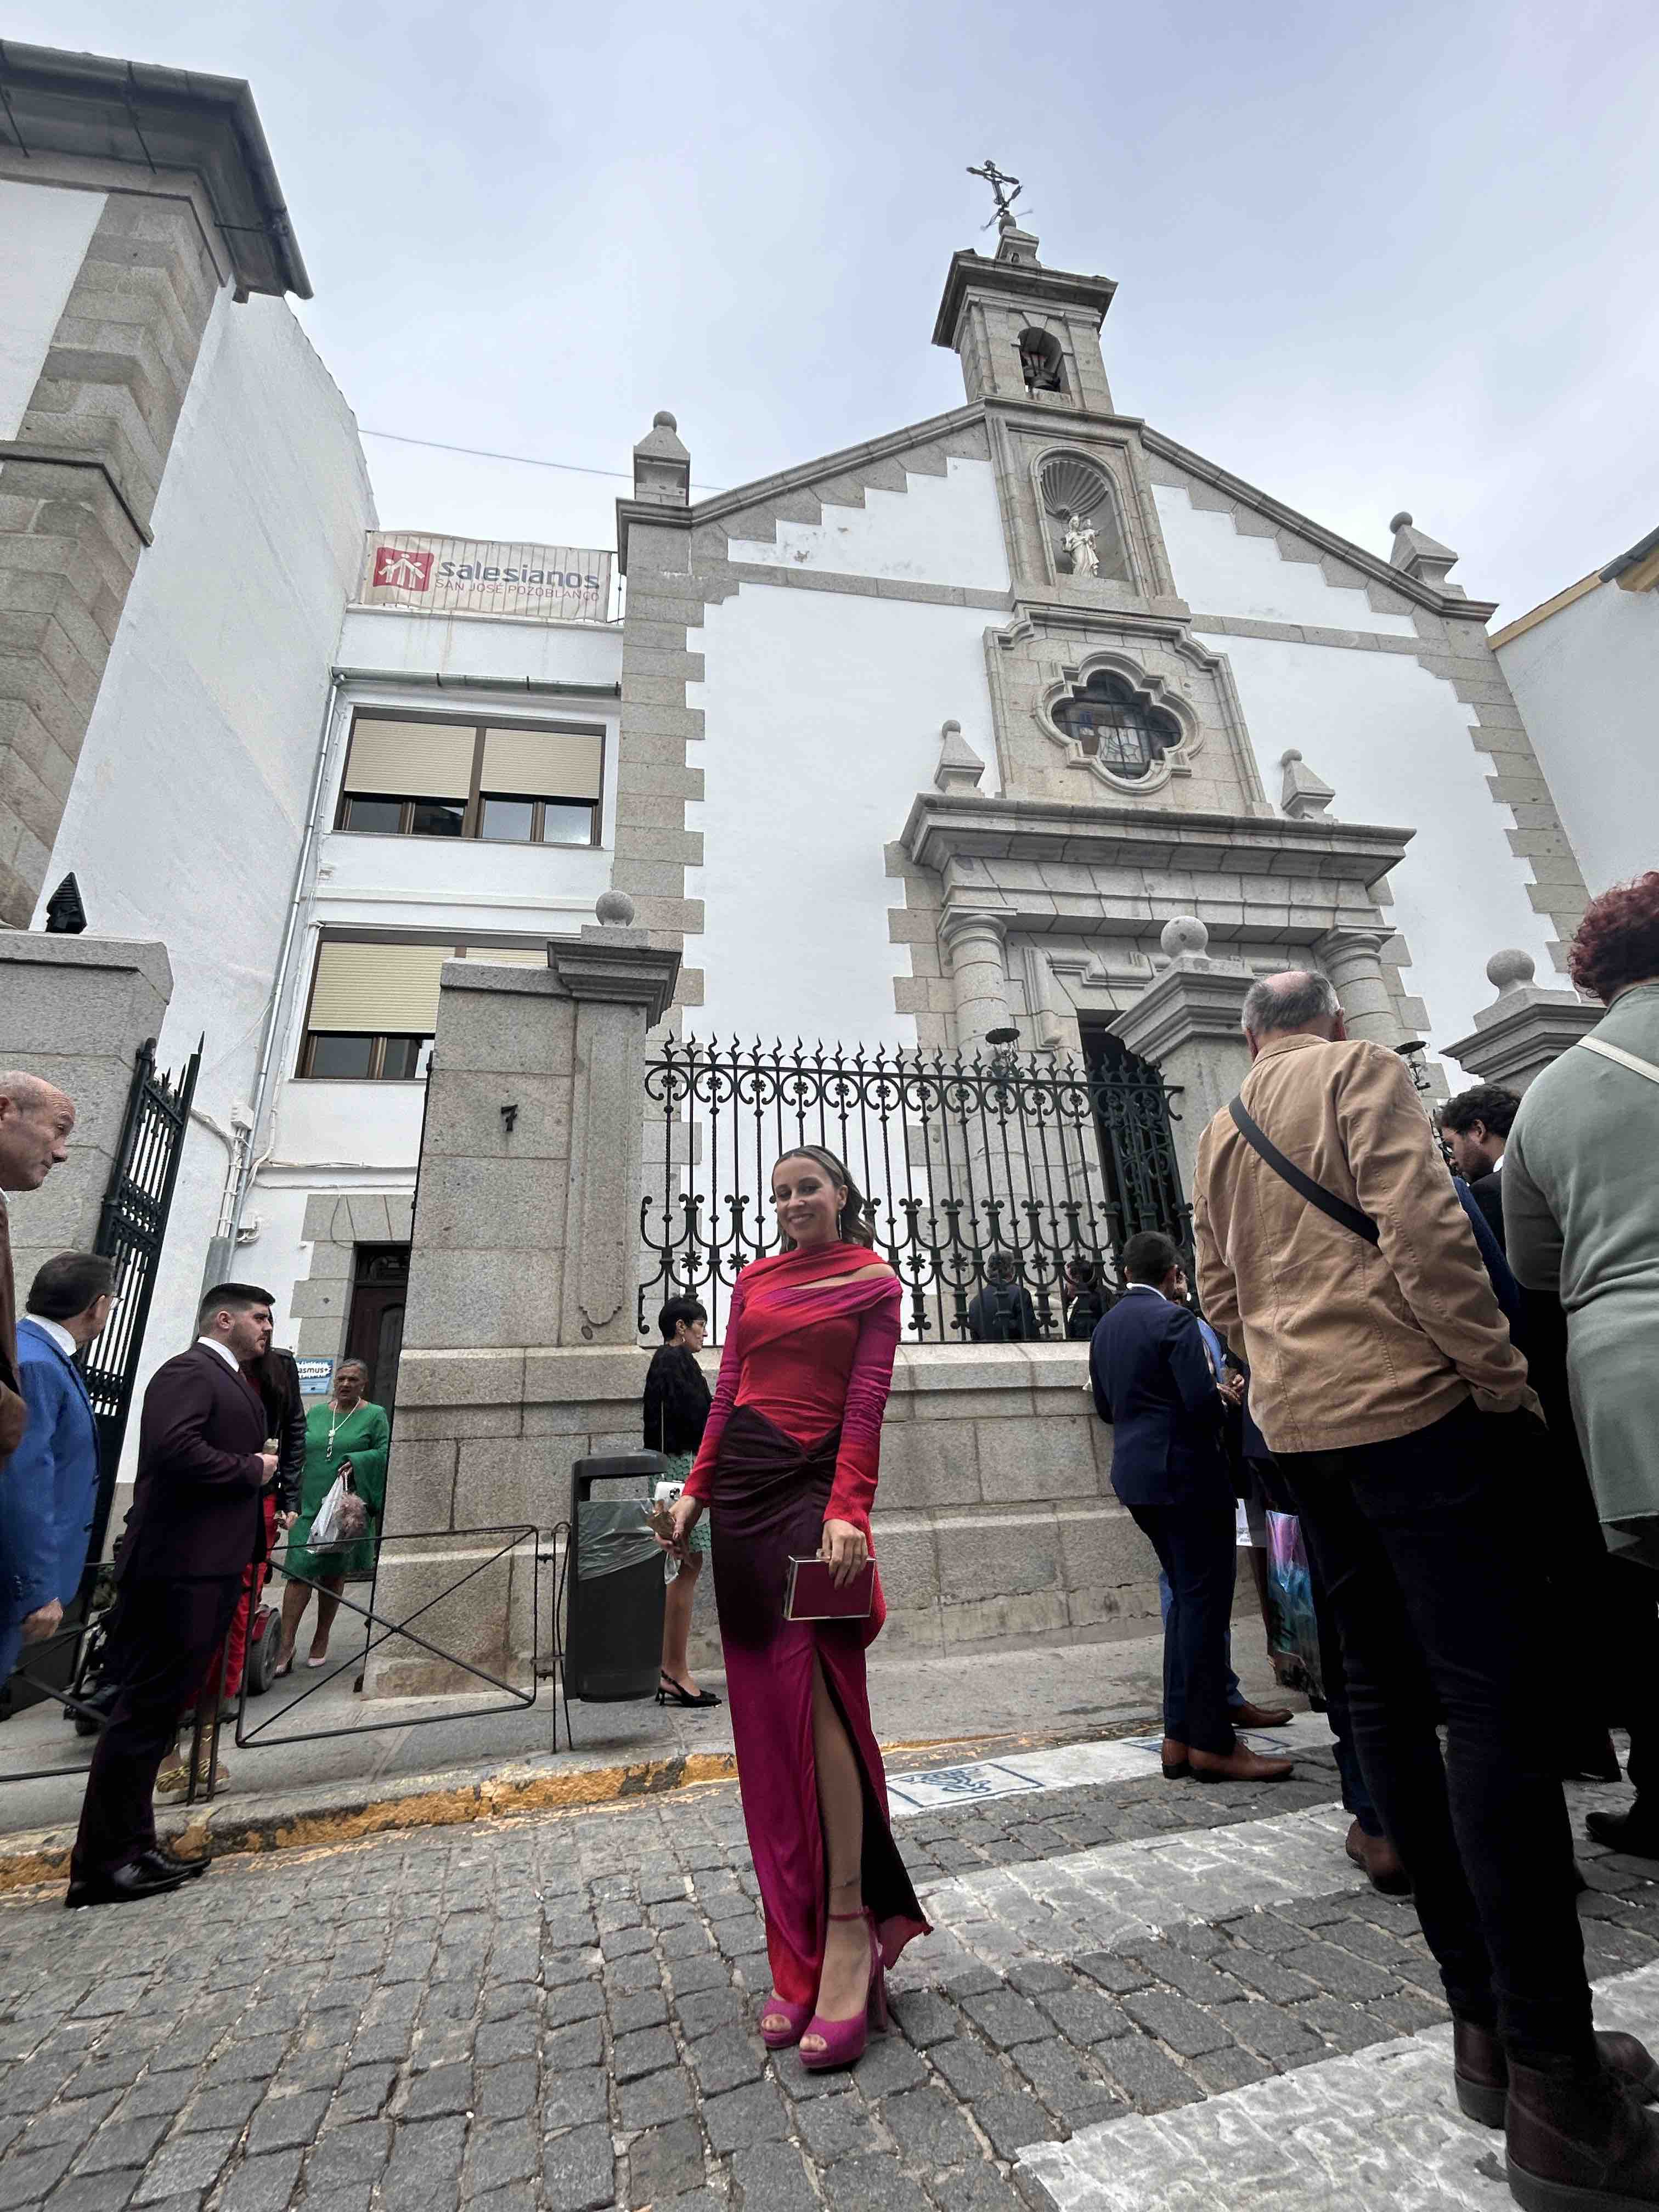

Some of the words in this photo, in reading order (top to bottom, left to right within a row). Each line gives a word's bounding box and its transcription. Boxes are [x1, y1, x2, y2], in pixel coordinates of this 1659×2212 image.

[437, 560, 600, 589] salesianos
[435, 578, 465, 591] SAN
[508, 584, 600, 601] POZOBLANCO
[501, 1104, 518, 1132] 7
